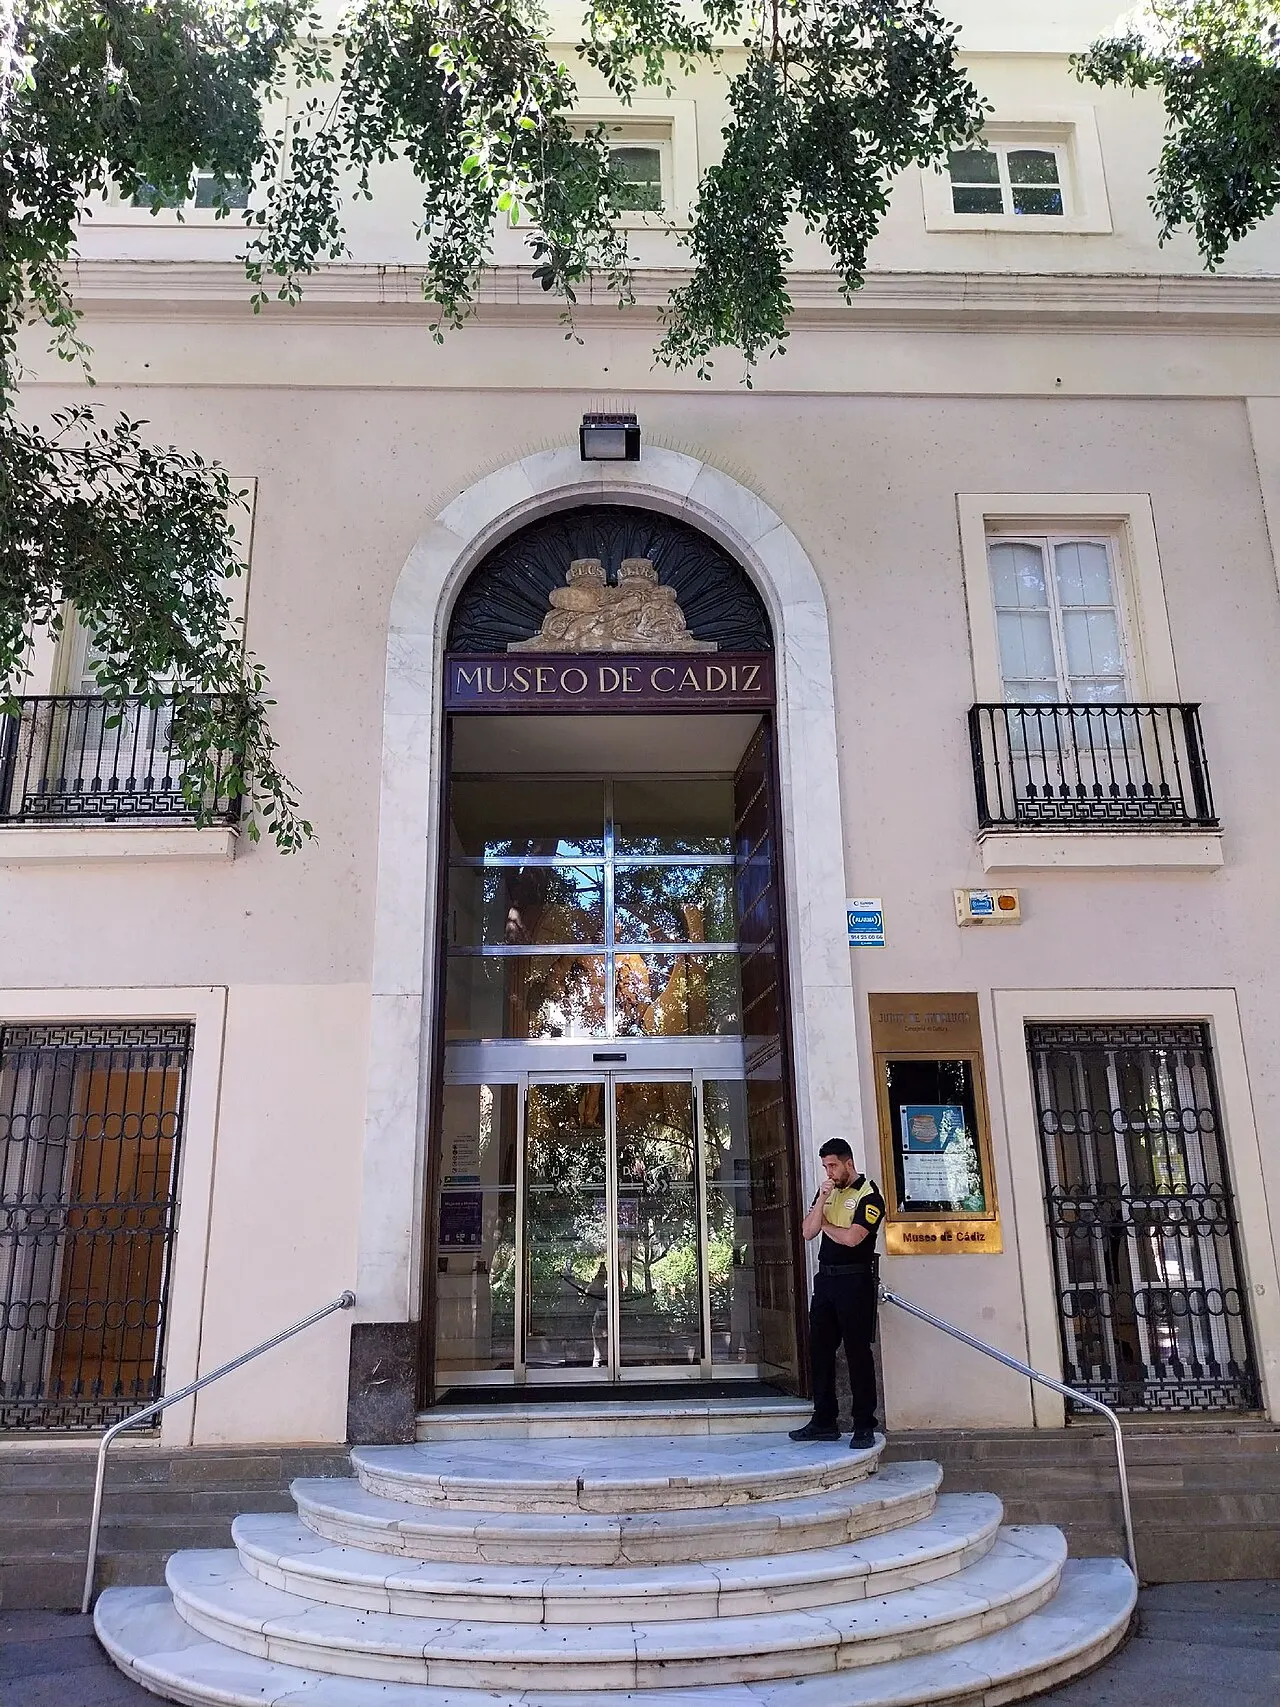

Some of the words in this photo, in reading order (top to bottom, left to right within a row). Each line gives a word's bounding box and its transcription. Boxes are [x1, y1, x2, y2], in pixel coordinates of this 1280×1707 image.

[456, 666, 588, 694] MUSEO
[599, 666, 643, 693] DE
[650, 665, 762, 692] CADIZ
[903, 1233, 937, 1243] Museo
[941, 1231, 953, 1241] de
[957, 1231, 986, 1241] Cádiz
